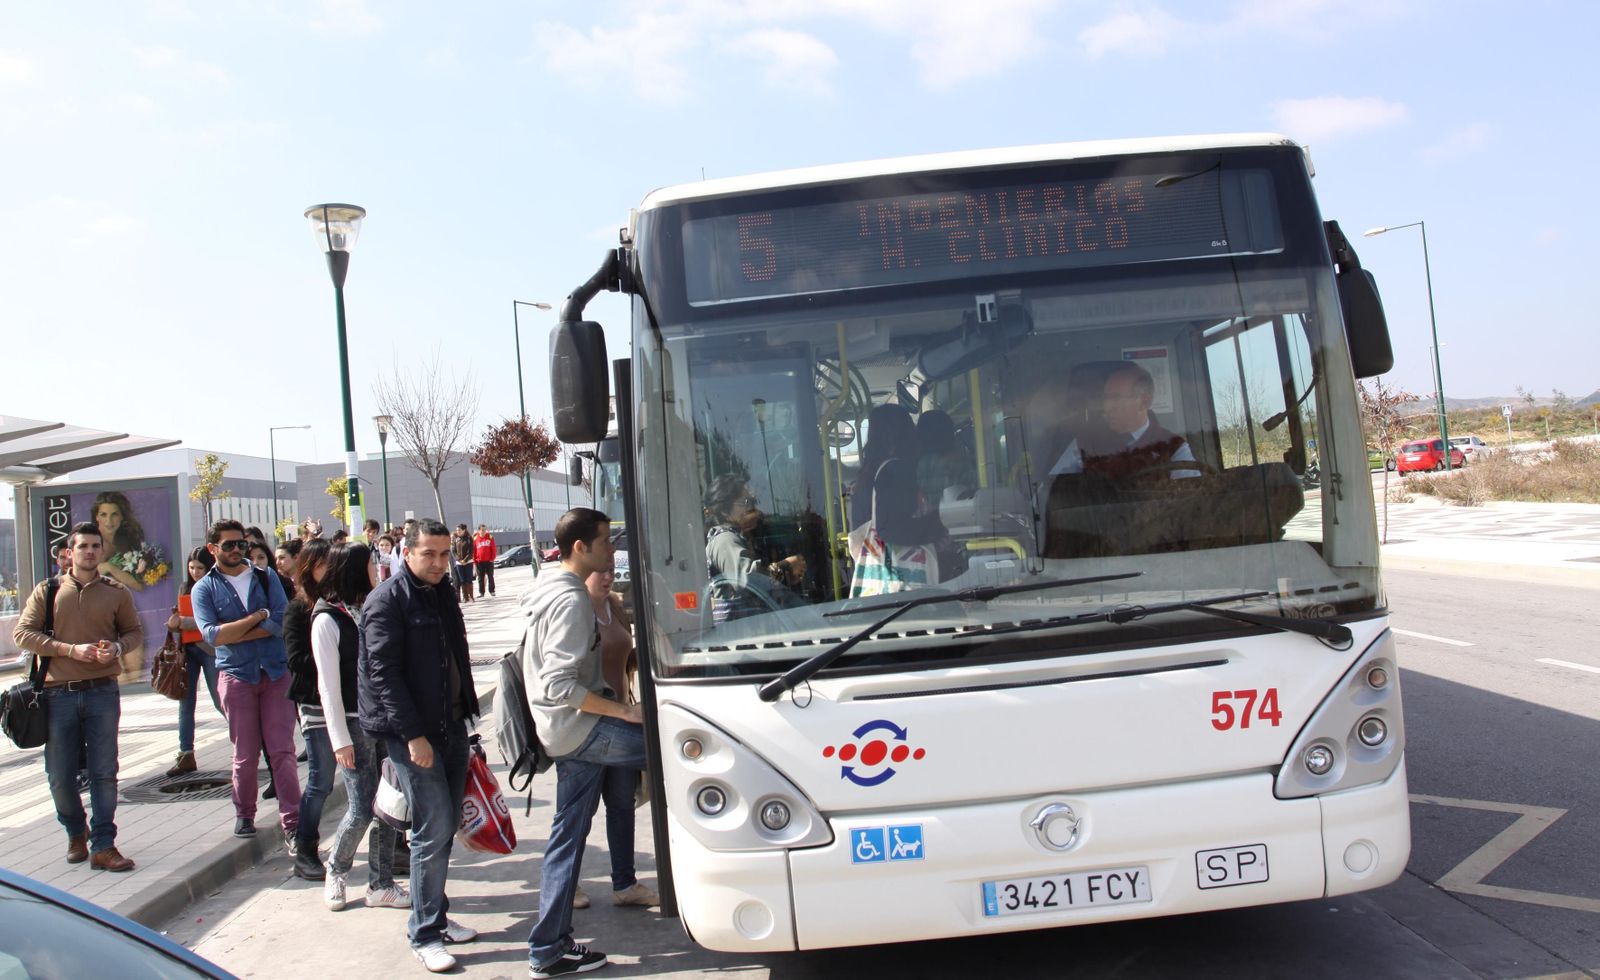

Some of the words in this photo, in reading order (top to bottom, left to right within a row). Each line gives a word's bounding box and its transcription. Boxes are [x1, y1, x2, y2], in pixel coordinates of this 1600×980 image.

[857, 180, 1145, 238] INGENIERIAS
[738, 213, 777, 281] 5
[949, 216, 1129, 263] CLINICO
[1211, 688, 1283, 731] 574
[1003, 878, 1073, 910] 3421
[1087, 871, 1140, 902] FCY
